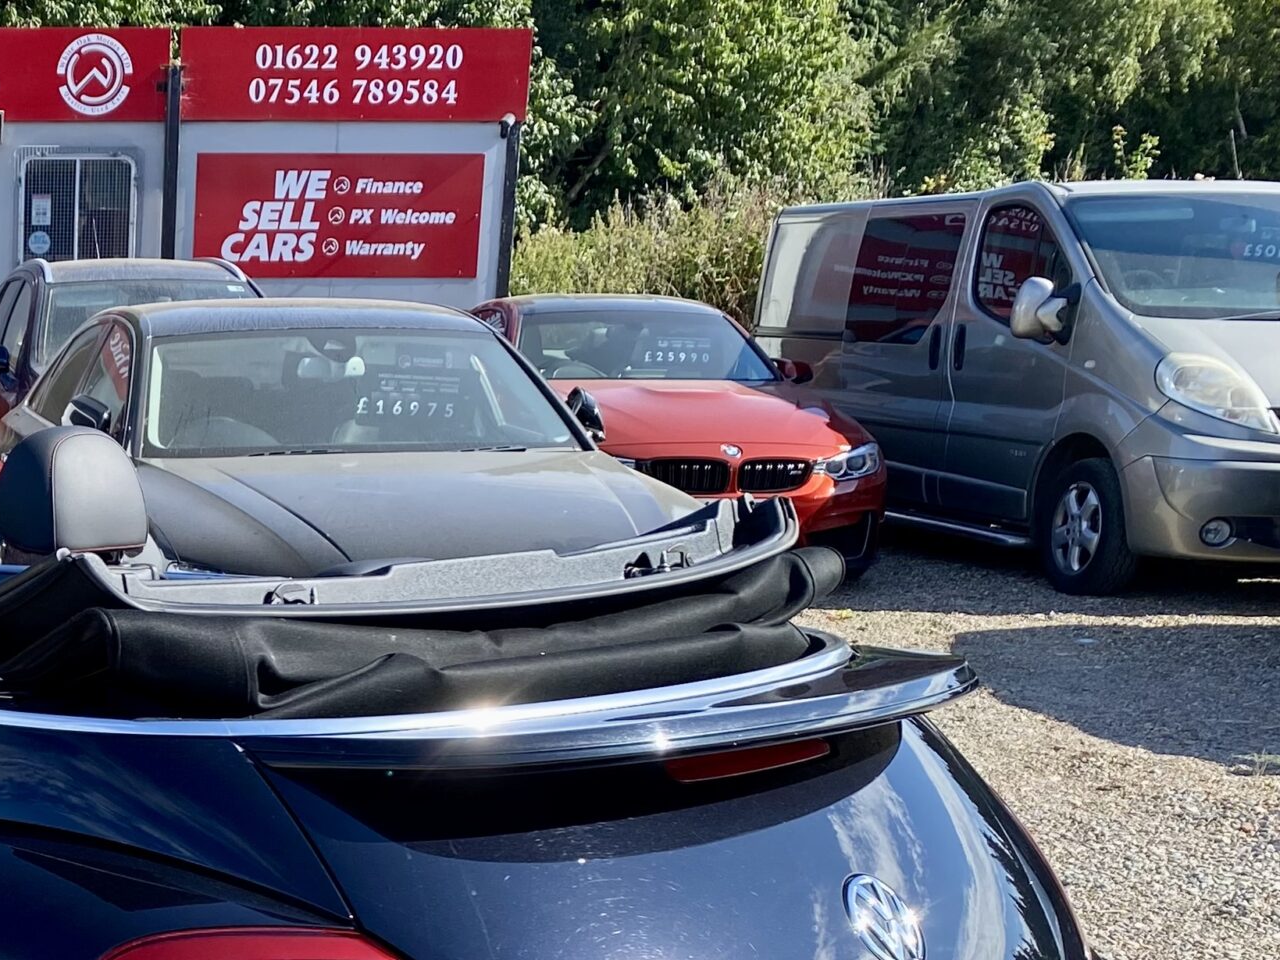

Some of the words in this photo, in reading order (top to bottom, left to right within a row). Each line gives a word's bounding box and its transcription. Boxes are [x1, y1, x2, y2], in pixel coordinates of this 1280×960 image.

[255, 43, 338, 70] 01622
[354, 43, 464, 71] 943920
[248, 77, 340, 104] 07546
[352, 78, 459, 105] 789584
[274, 169, 331, 200] WE
[355, 177, 424, 195] Finance
[238, 200, 320, 231] SELL
[349, 208, 374, 225] PX
[380, 208, 457, 225] Welcome
[221, 232, 317, 262] CARS
[345, 240, 426, 260] Warranty
[1243, 243, 1280, 258] £50
[644, 350, 710, 363] £25990
[356, 396, 454, 418] £16975
